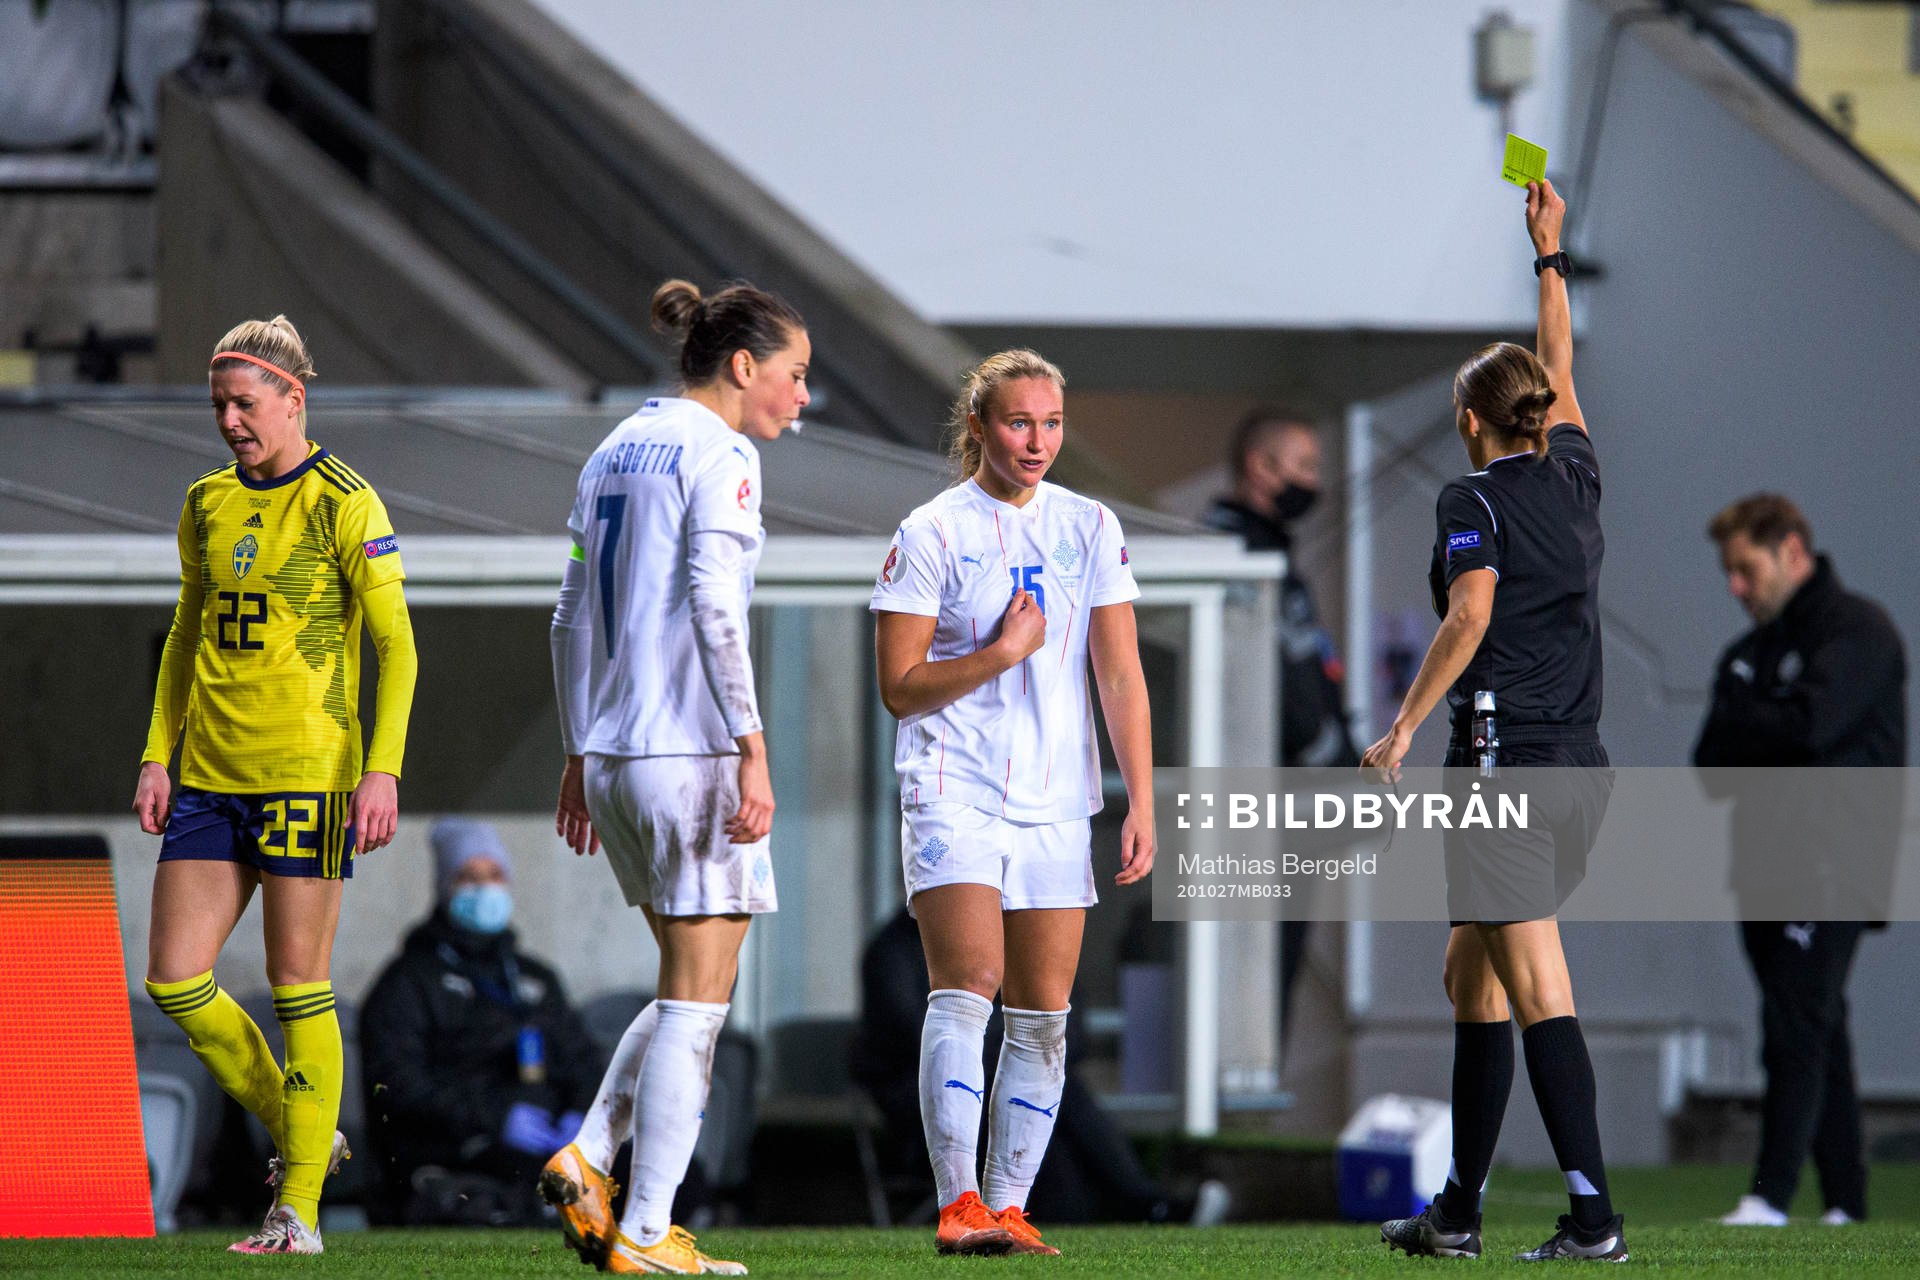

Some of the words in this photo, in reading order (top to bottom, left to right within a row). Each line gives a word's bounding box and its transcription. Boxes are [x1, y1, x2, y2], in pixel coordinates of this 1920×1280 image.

[1450, 534, 1479, 546] SPECT
[597, 494, 627, 659] 7
[217, 591, 268, 650] 22
[258, 800, 318, 858] 22
